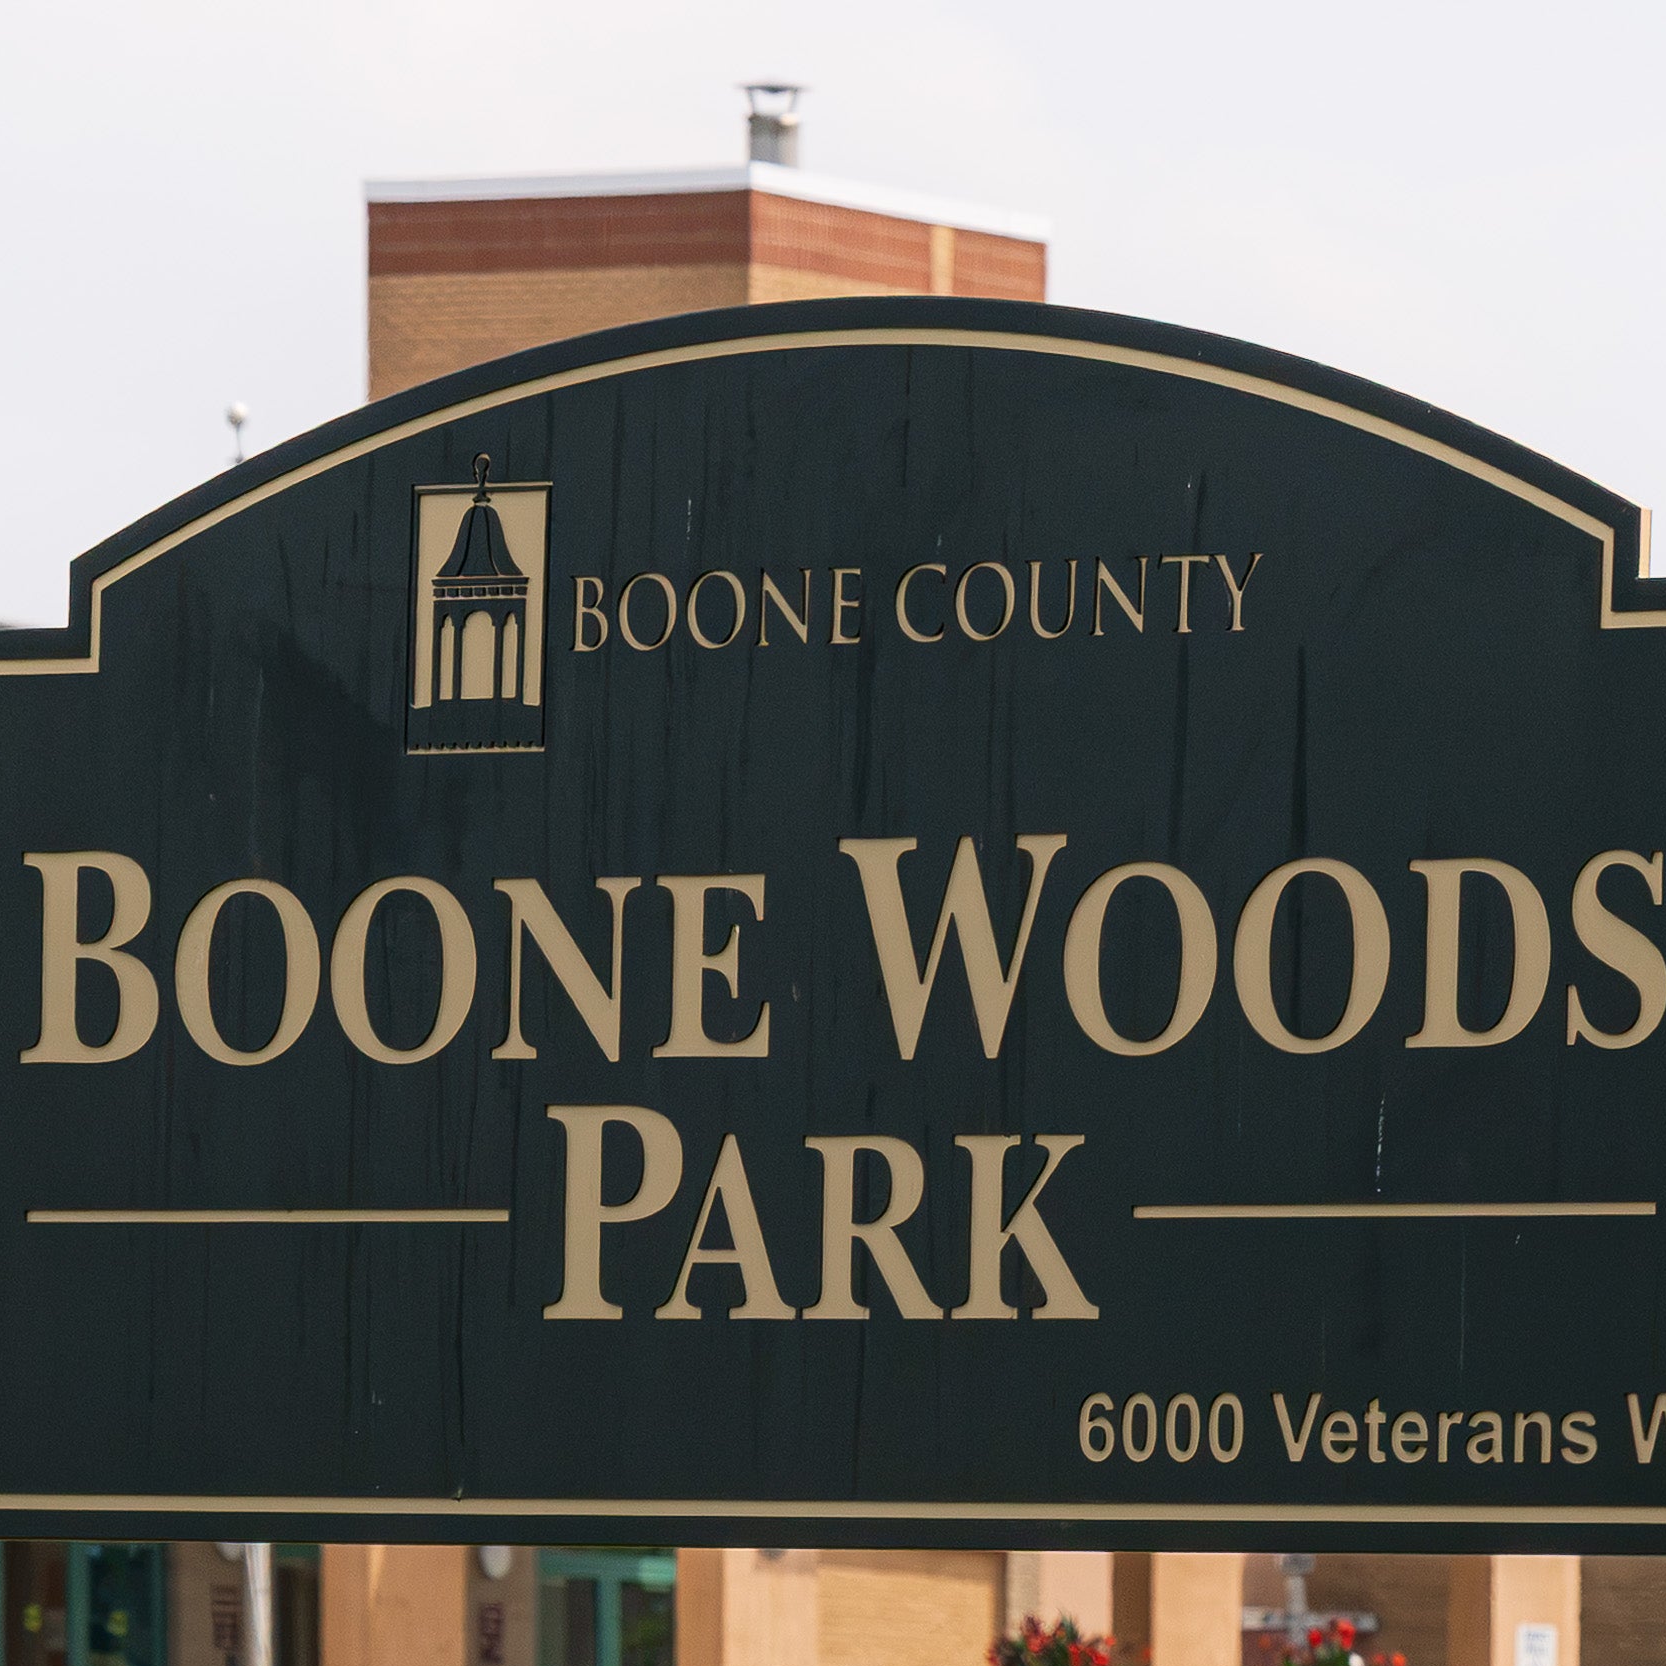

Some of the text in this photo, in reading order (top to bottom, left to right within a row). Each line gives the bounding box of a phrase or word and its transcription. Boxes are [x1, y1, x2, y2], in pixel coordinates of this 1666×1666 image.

[569, 552, 1265, 653] BOONE COUNTY
[18, 850, 773, 1067] BOONE
[541, 1104, 1102, 1321] PARK
[1077, 1391, 1245, 1464] 6000
[1272, 1391, 1599, 1465] Veterans
